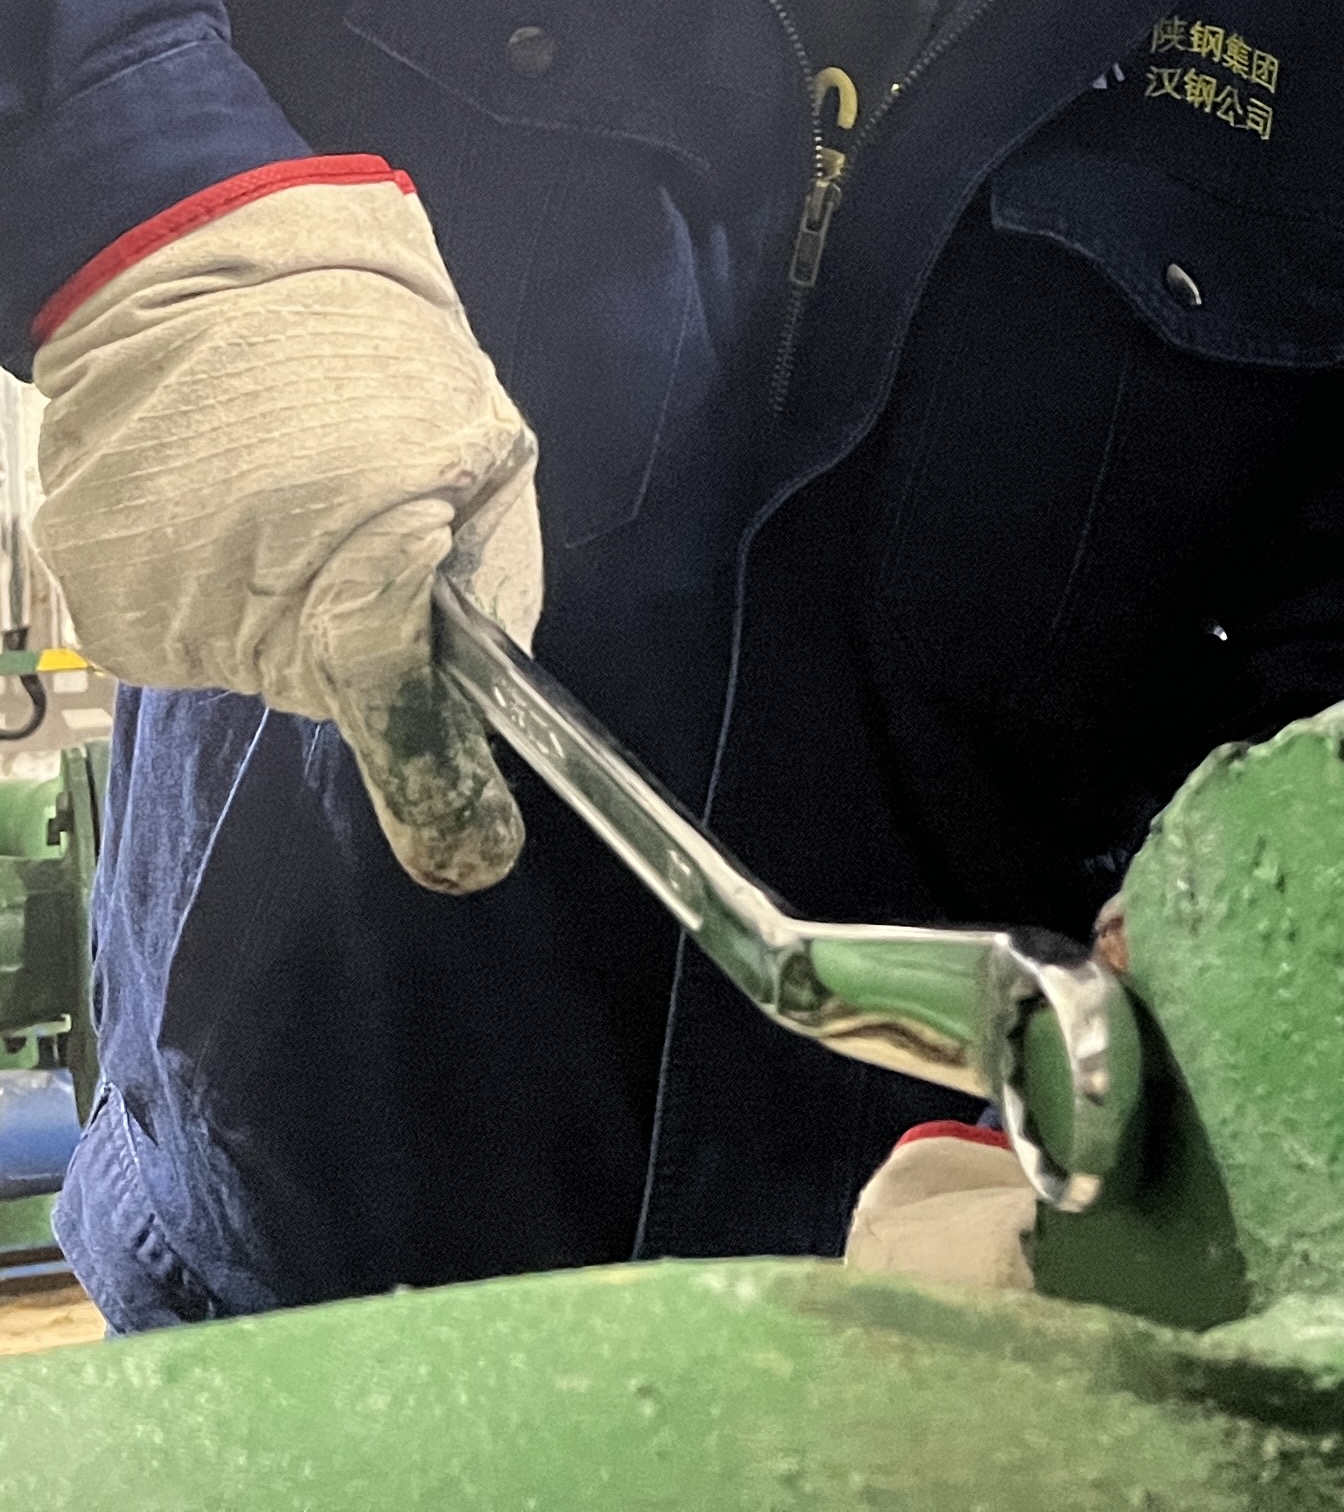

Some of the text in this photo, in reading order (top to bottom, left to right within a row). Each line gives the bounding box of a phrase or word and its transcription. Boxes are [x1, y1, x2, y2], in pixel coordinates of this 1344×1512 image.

[1150, 15, 1280, 94] 陕钢集团
[1144, 64, 1274, 140] 汉钢公司
